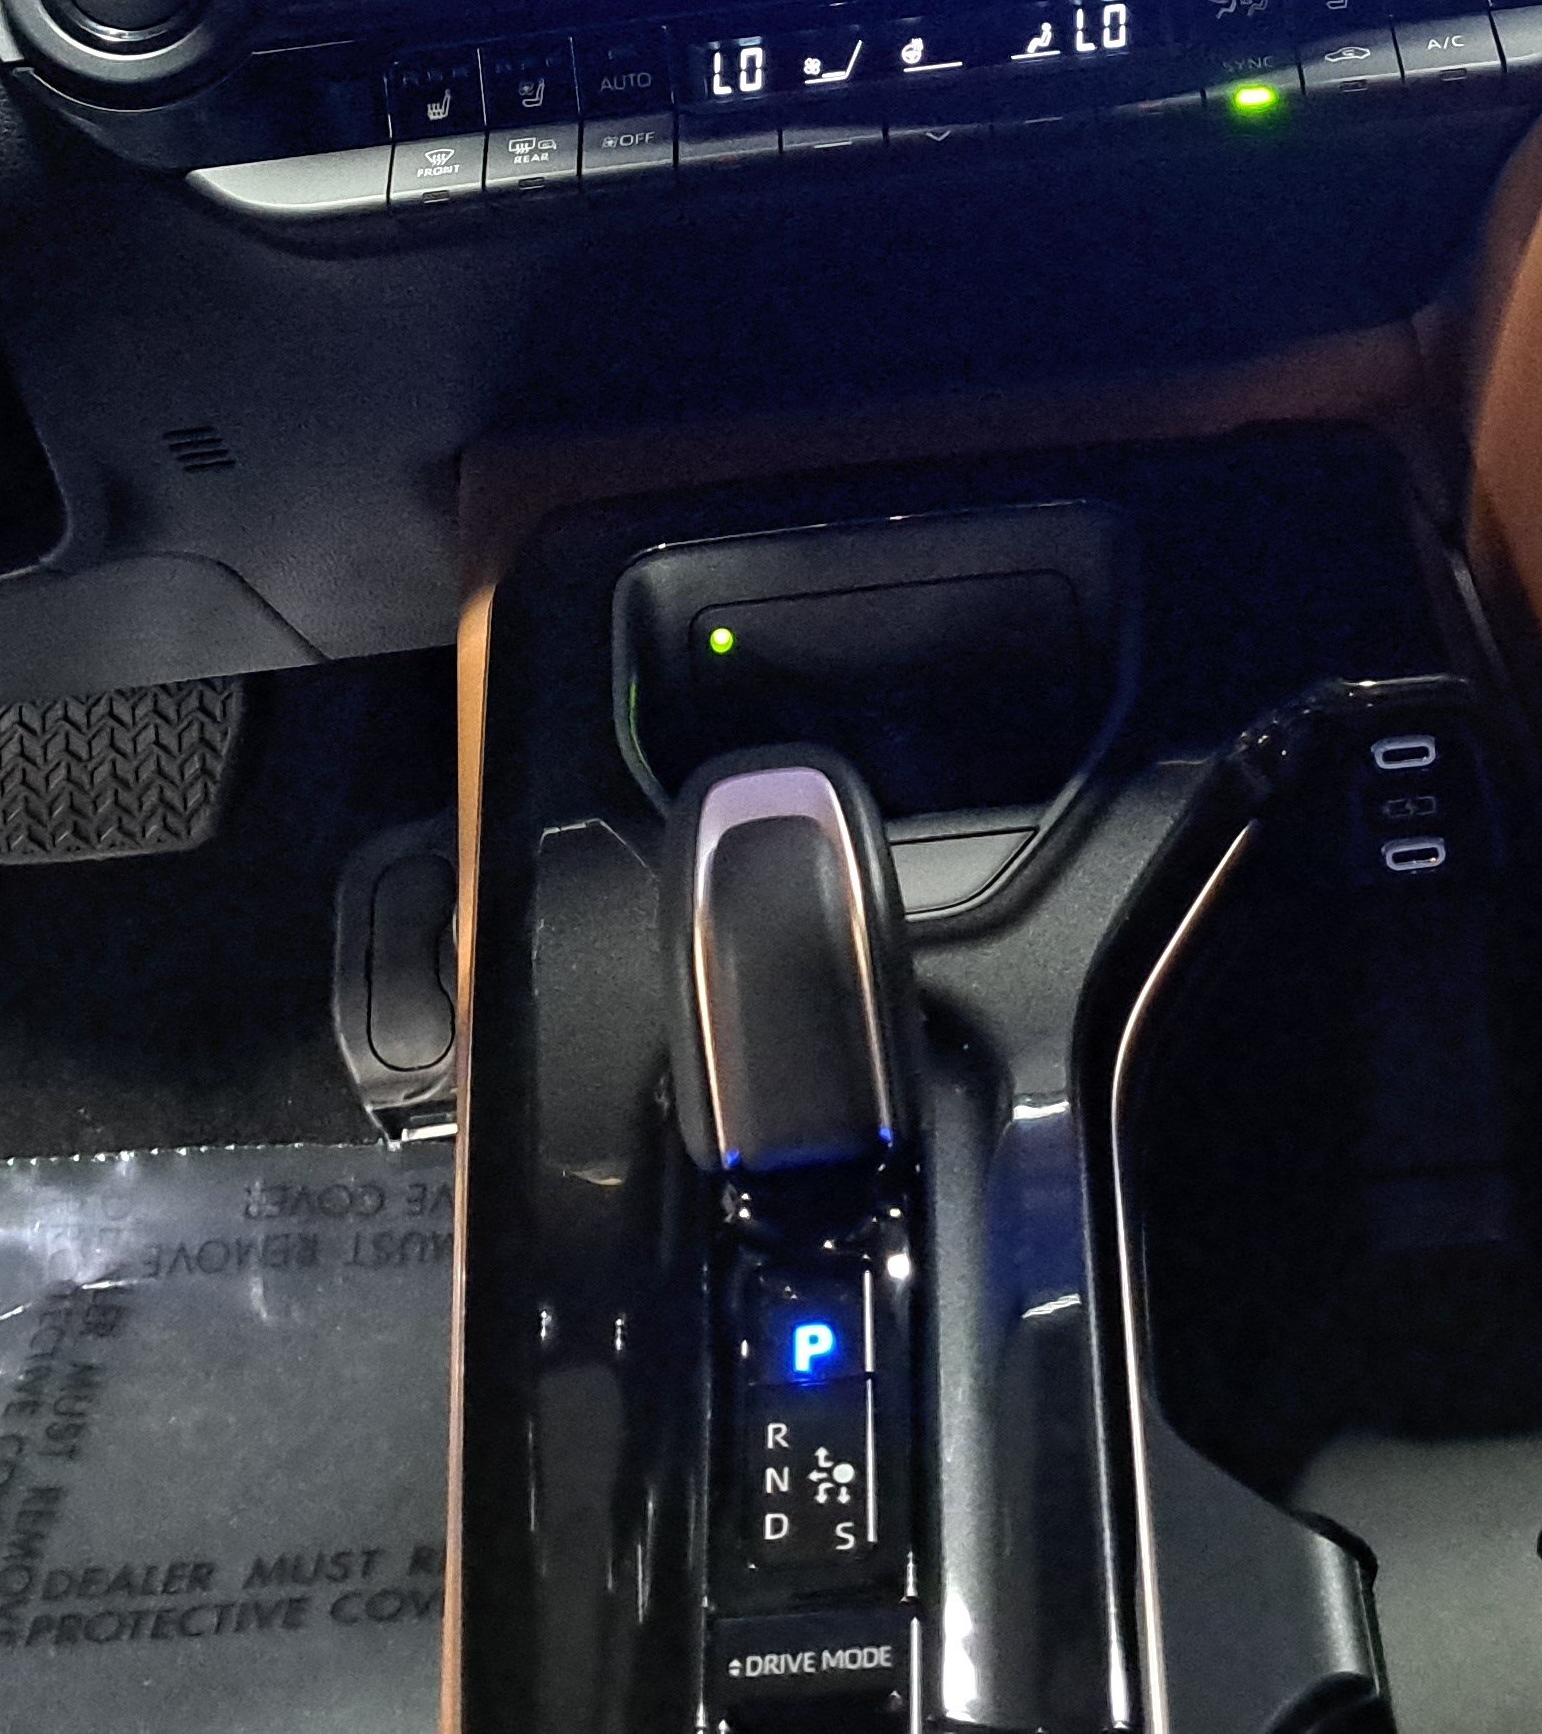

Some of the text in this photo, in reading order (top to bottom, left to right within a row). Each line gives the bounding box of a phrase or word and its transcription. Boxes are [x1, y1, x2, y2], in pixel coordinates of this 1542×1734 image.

[1427, 34, 1465, 51] A/C
[599, 72, 652, 93] AUTO
[619, 131, 656, 147] OFF
[416, 164, 461, 179] FRONT
[513, 152, 550, 164] REAR
[795, 1322, 835, 1372] P
[766, 1422, 790, 1450] R
[765, 1466, 790, 1494] N
[764, 1513, 790, 1541] D
[835, 1522, 855, 1551] S
[39, 1561, 216, 1600] DEALER
[241, 1548, 387, 1590] MUST
[24, 1595, 311, 1647] PROTECTIVE
[745, 1645, 893, 1679] DRIVE MODE
